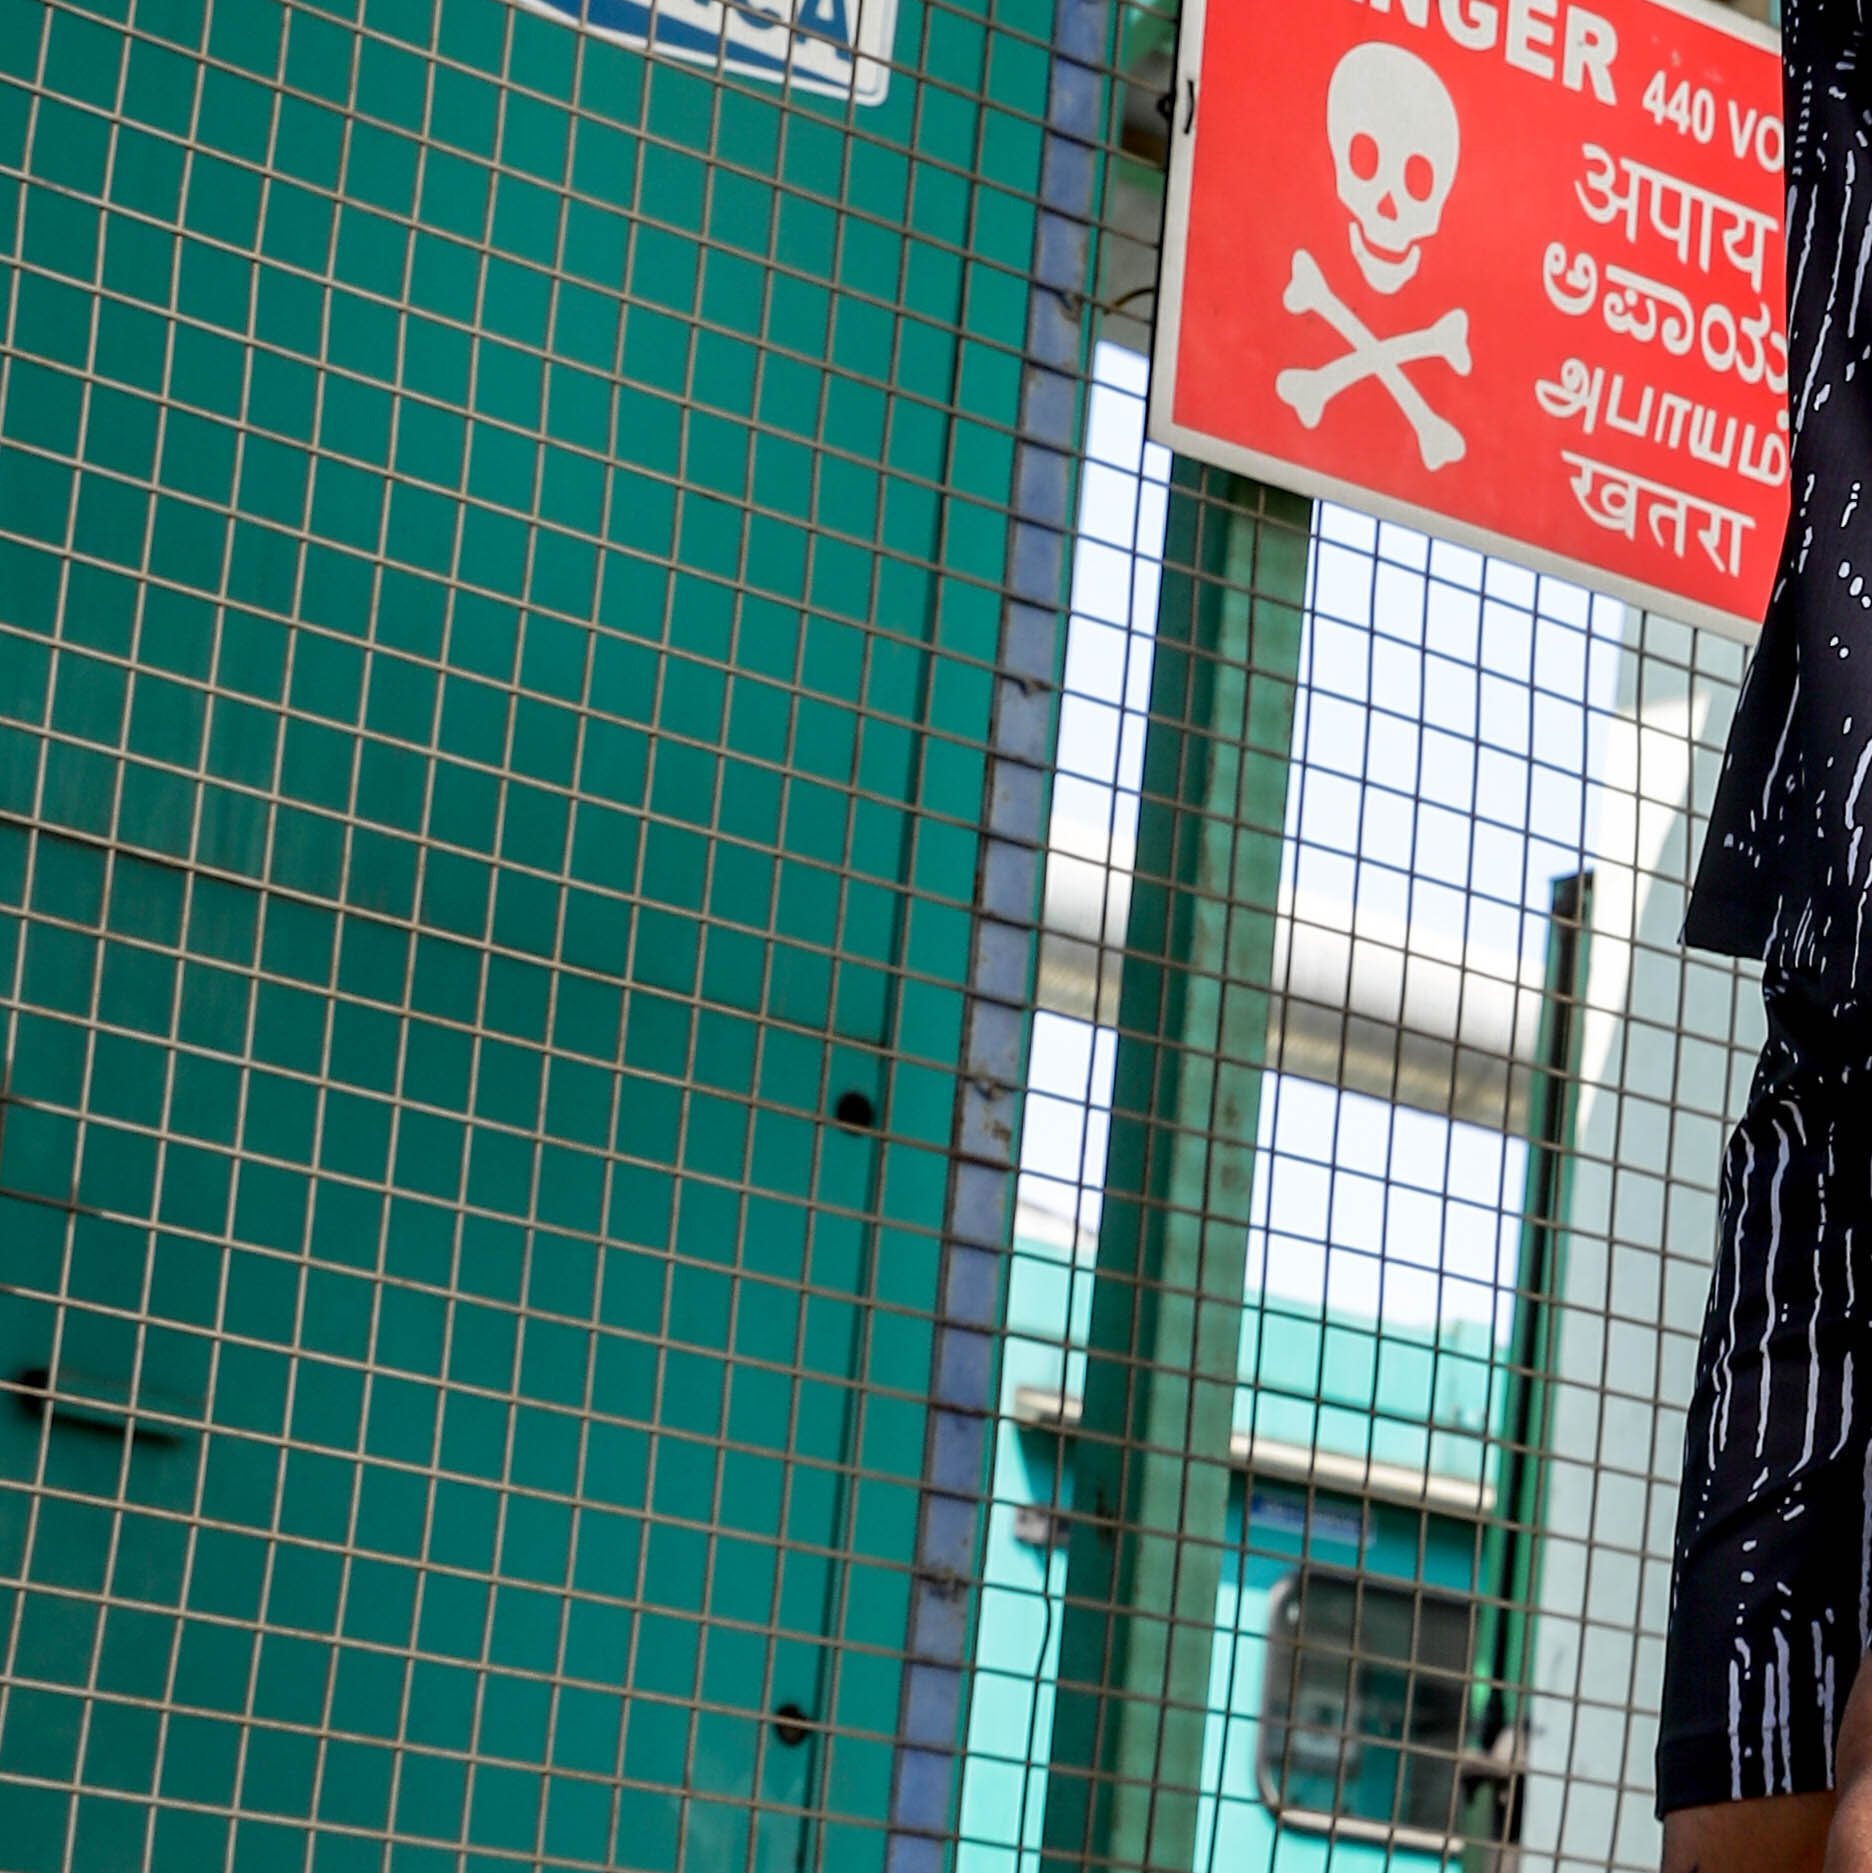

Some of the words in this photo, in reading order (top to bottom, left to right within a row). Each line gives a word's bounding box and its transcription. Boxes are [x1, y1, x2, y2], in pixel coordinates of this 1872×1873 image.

[1641, 70, 1715, 146] 440
[1574, 142, 1778, 293] अपाय
[1535, 357, 1789, 487] அபாயம்
[1560, 448, 1757, 578] खतरा
